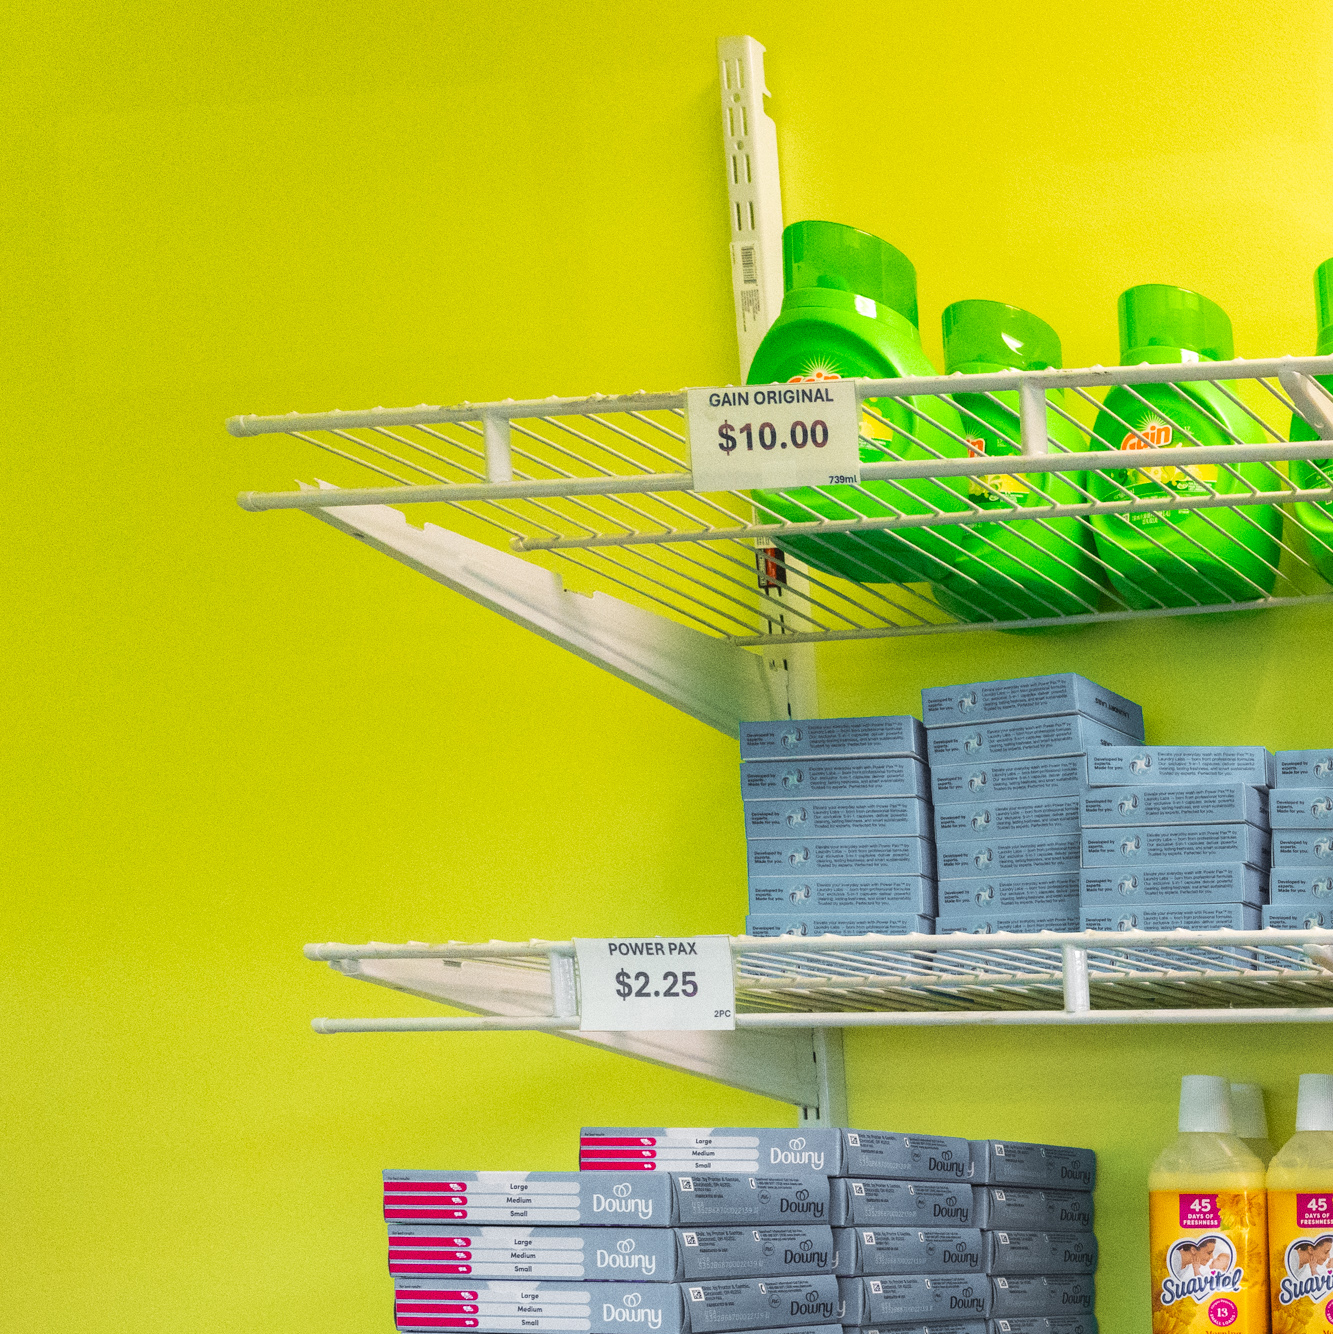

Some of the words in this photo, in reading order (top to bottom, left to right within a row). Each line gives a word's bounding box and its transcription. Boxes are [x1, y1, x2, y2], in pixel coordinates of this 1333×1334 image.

[709, 390, 749, 408] GAIN
[753, 387, 834, 406] ORIGINAL
[718, 420, 829, 456] $10.00
[1122, 425, 1171, 449] Gain
[829, 474, 858, 485] 739ml
[608, 942, 664, 956] POWER
[668, 942, 698, 955] PAX
[615, 968, 698, 1001] $2.25
[714, 1010, 731, 1018] 2PC
[770, 1148, 824, 1170] Downy
[593, 1194, 652, 1219] Downy
[780, 1199, 823, 1218] Downy
[1190, 1199, 1211, 1212] 45
[597, 1250, 655, 1275] Downy
[1162, 1269, 1242, 1304] Suavitel
[602, 1300, 662, 1329] Downy
[1217, 1308, 1228, 1317] 13
